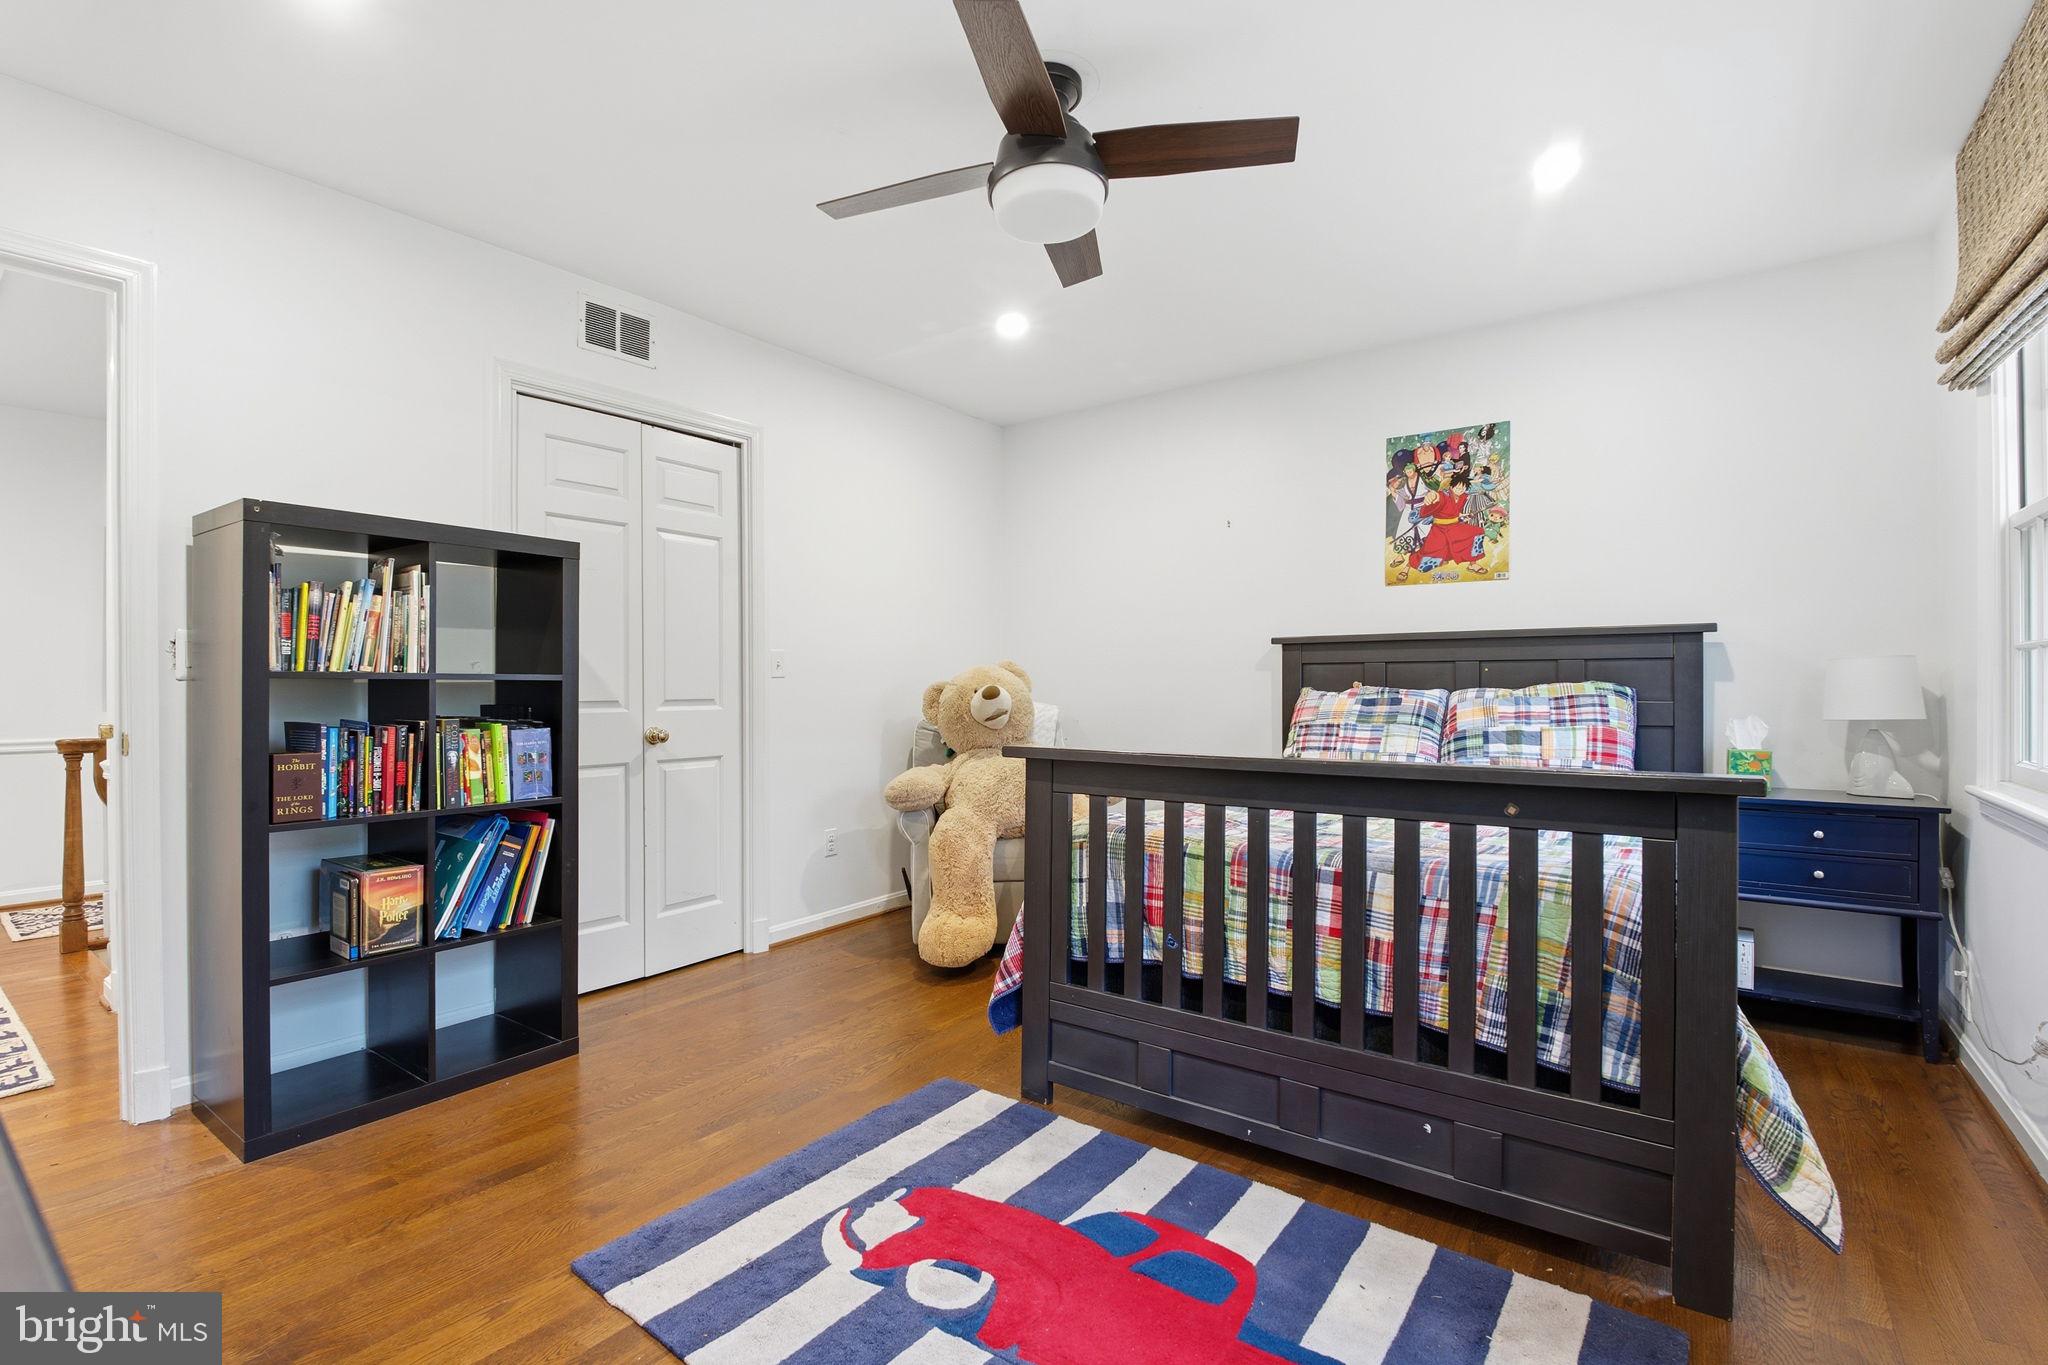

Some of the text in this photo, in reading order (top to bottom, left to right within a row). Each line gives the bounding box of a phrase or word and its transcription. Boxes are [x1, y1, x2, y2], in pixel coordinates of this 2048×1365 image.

[307, 614, 321, 640] ALLIES
[277, 762, 316, 772] HOBBIT
[277, 806, 313, 816] RINGS
[387, 874, 412, 882] ROWLING
[381, 895, 409, 911] Harry
[379, 910, 409, 928] Potter
